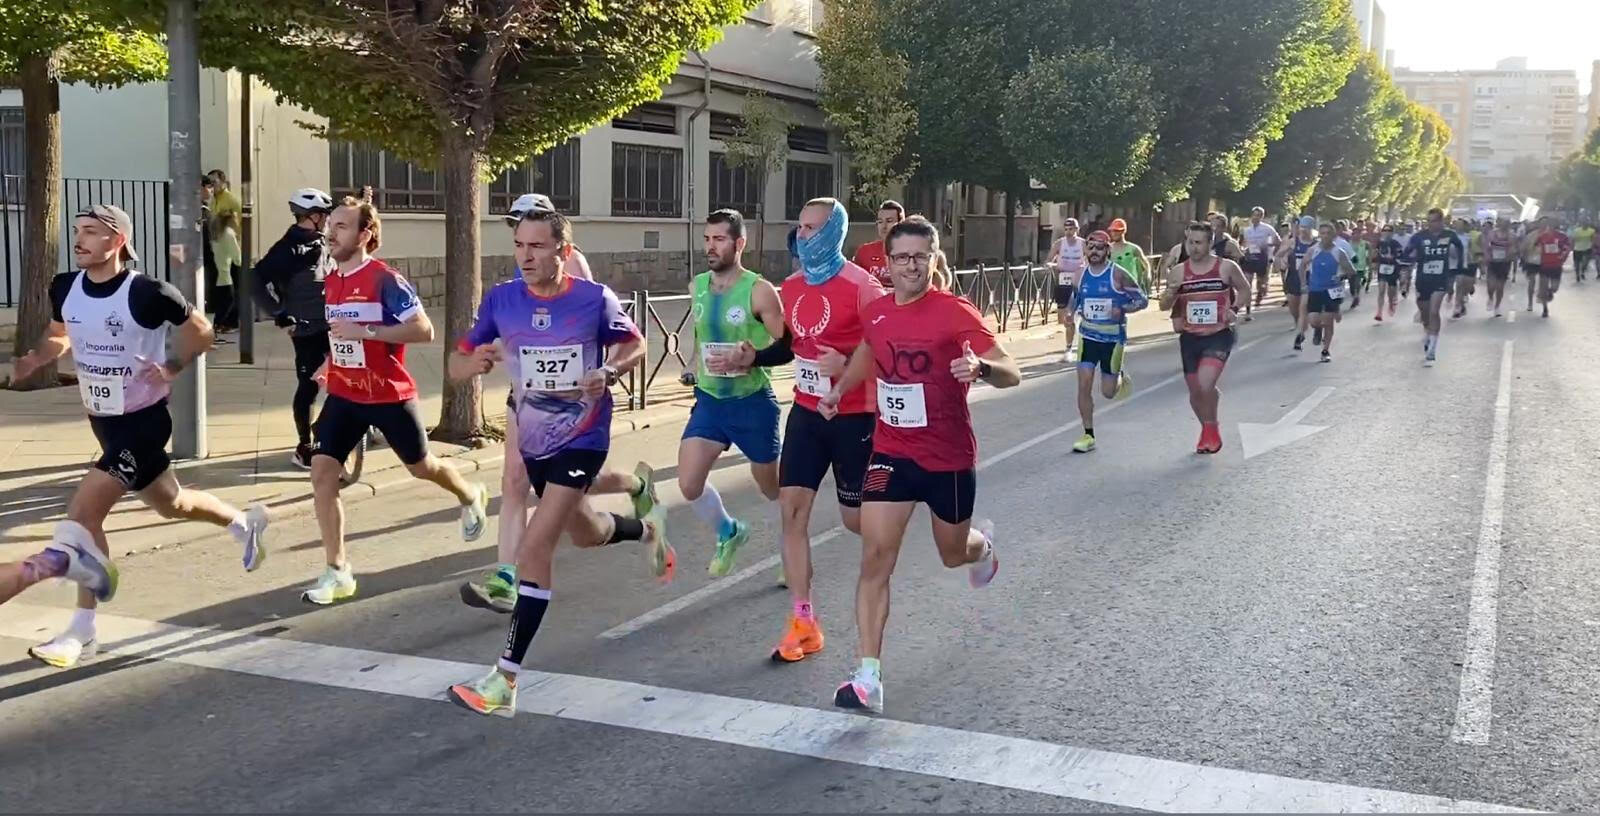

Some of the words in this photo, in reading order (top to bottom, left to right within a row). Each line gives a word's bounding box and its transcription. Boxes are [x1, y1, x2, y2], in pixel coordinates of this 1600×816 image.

[1090, 304, 1105, 312] 122
[1192, 308, 1210, 316] 278
[334, 343, 354, 354] 228
[535, 359, 569, 373] 327
[800, 368, 819, 381] 251
[88, 385, 111, 398] 109
[886, 396, 905, 410] 55
